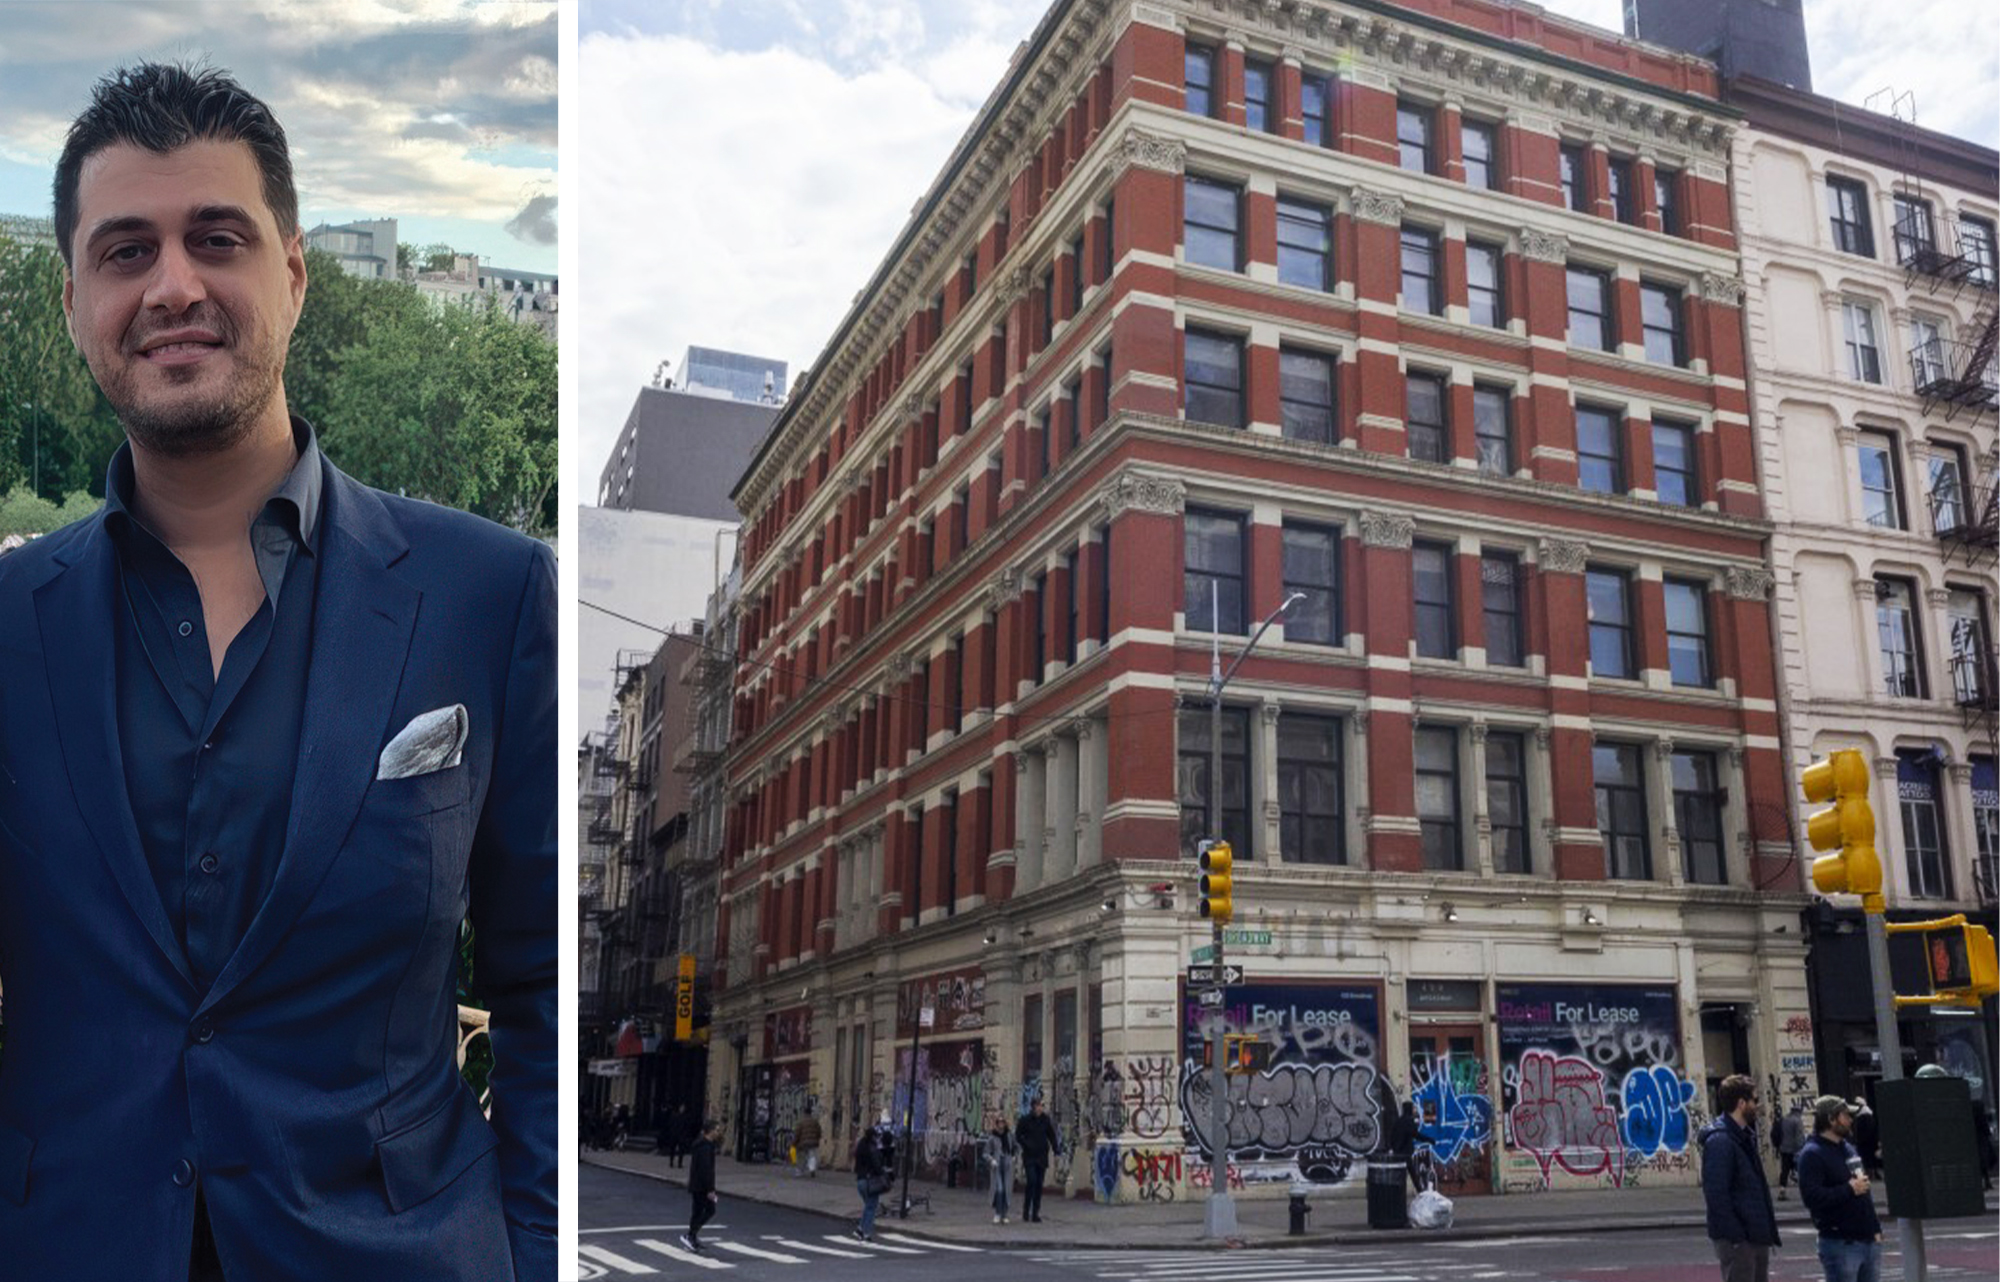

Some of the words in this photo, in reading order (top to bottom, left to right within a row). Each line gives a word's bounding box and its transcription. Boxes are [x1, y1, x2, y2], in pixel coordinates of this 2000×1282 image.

[678, 975, 691, 1018] GOLF
[1253, 1004, 1287, 1026] For
[1291, 1004, 1351, 1026] Lease
[1556, 1002, 1585, 1023] For
[1589, 1002, 1639, 1023] Lease
